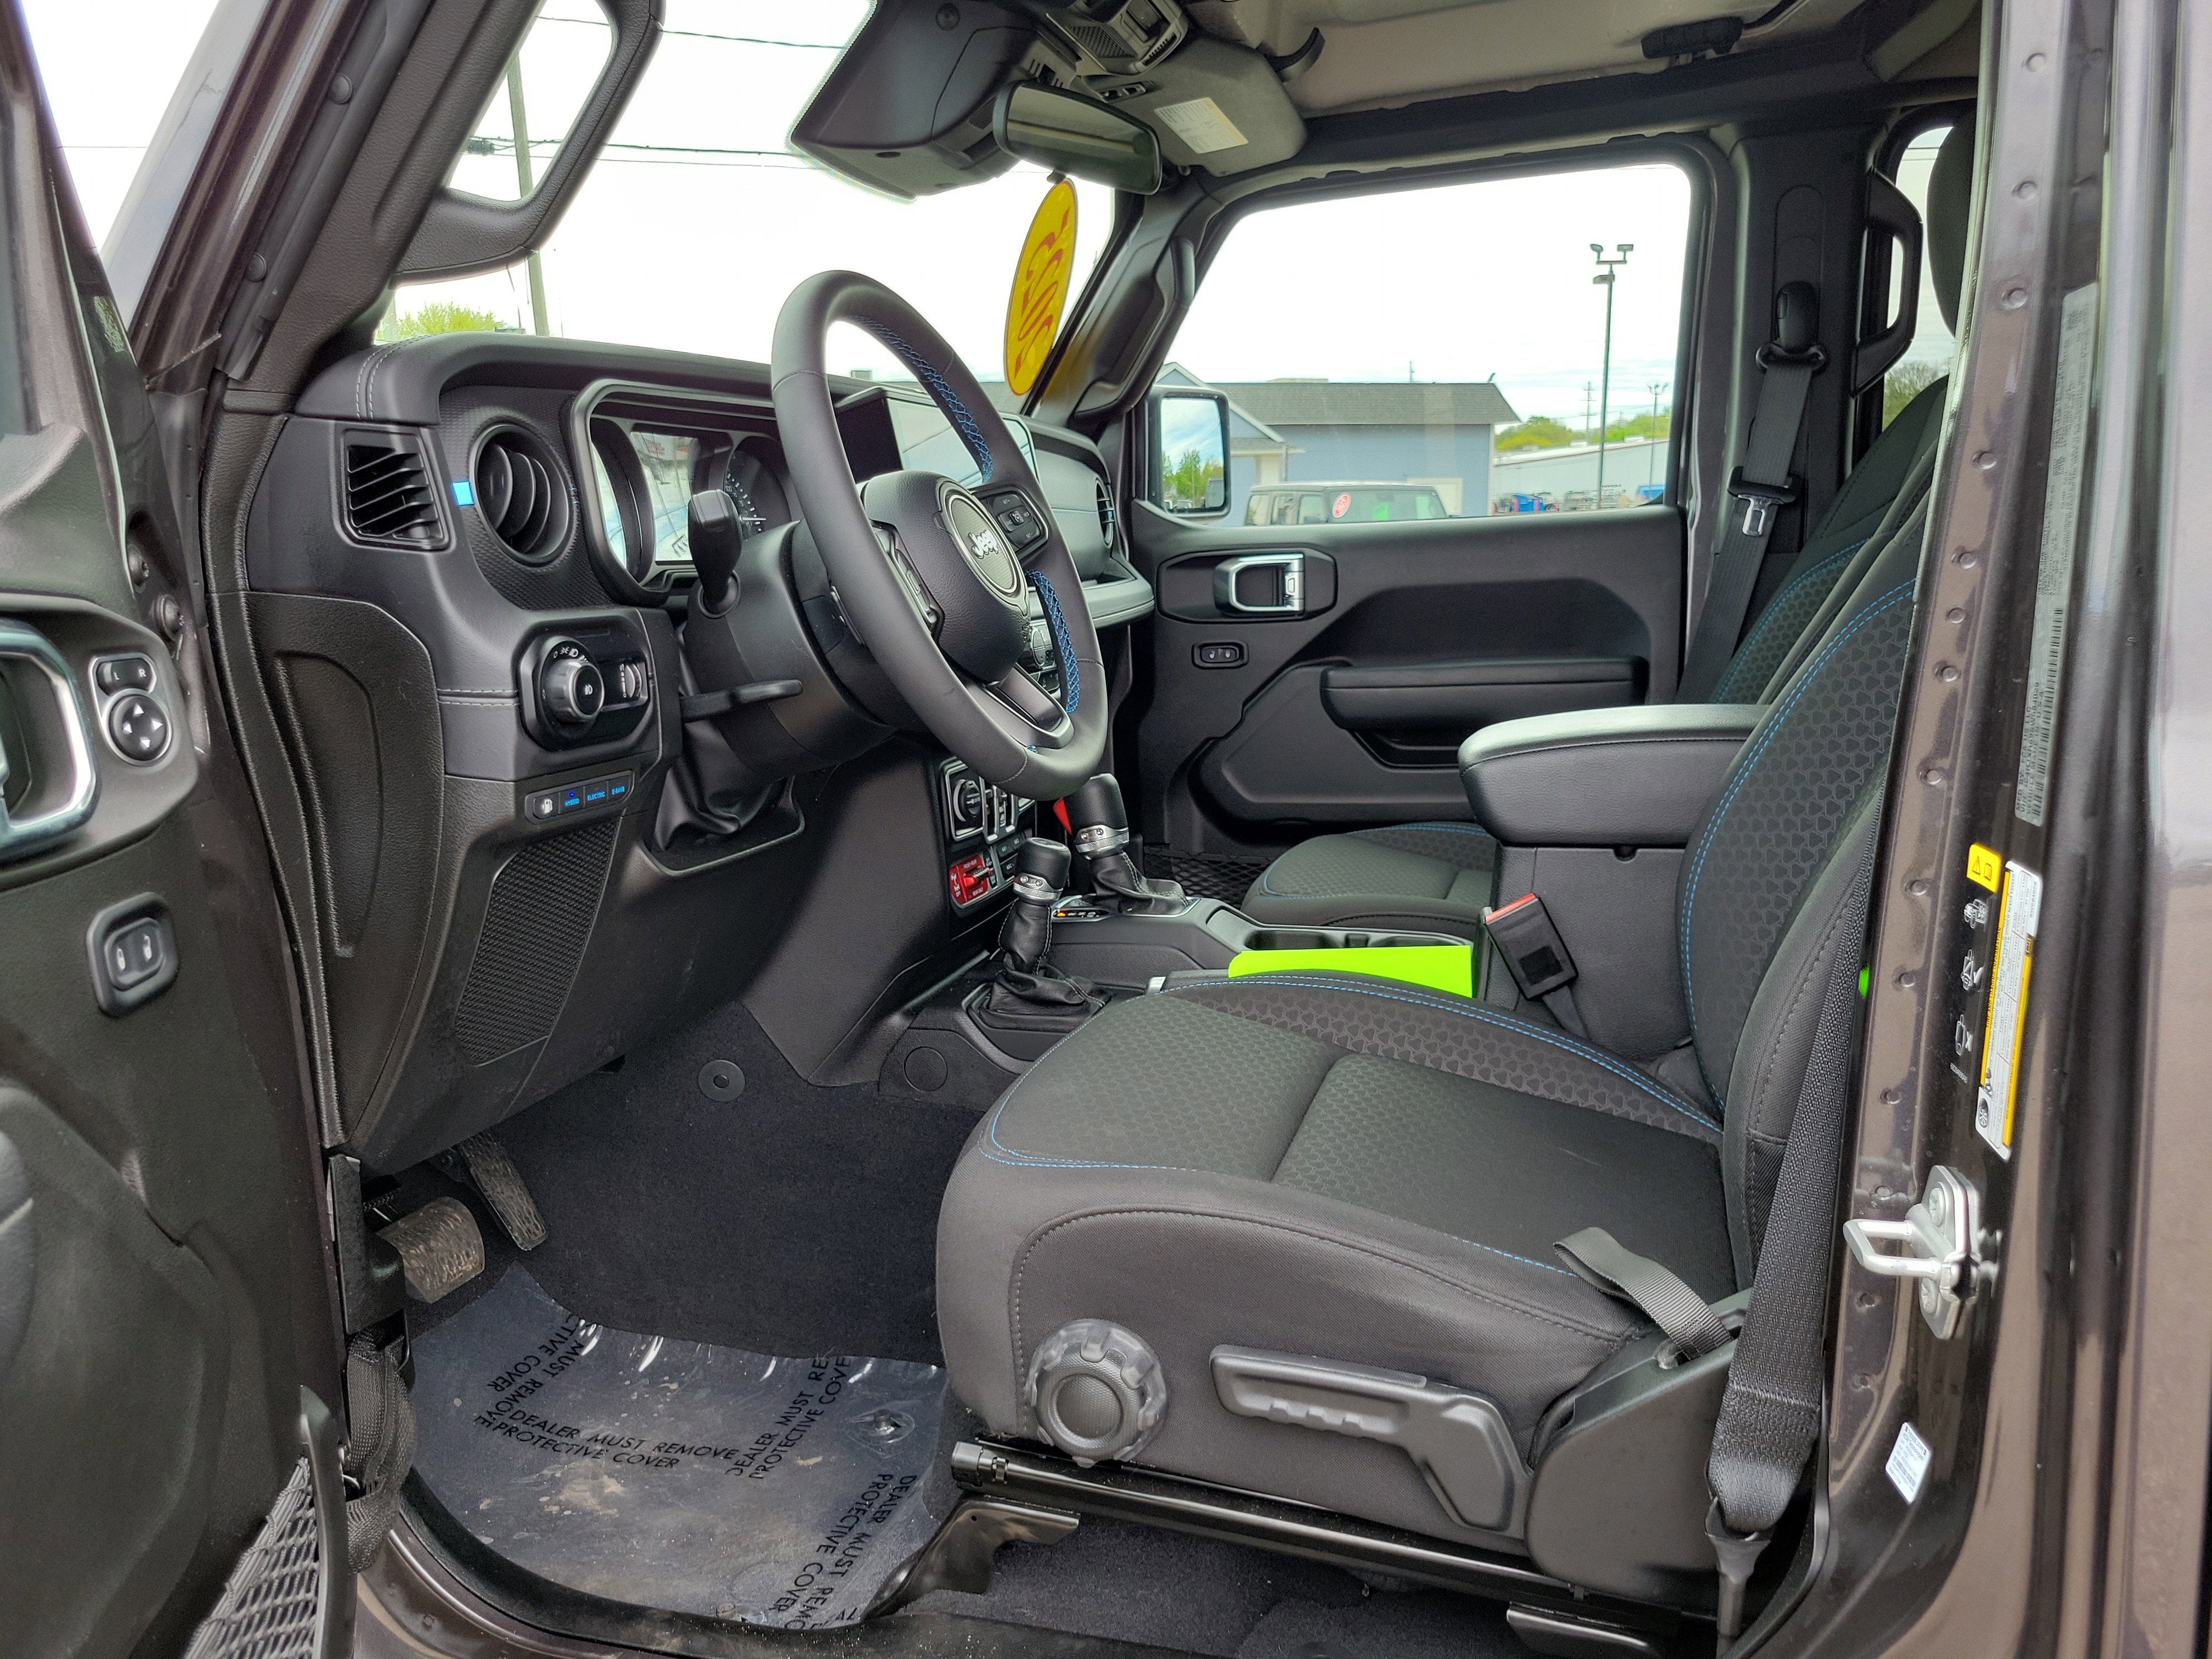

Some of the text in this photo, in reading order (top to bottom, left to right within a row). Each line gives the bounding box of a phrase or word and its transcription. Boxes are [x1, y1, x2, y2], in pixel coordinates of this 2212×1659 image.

[968, 528, 1000, 558] Jeep
[113, 668, 147, 681] L R
[586, 791, 606, 801] ELECTRIC
[475, 1340, 584, 1427] MUST REMOVE
[487, 1355, 540, 1392] COVER
[775, 1391, 814, 1425] MUST
[493, 1421, 680, 1468] PROTECTIVE COVER
[509, 1410, 739, 1459] DEALER MUST REMOVE
[749, 1409, 825, 1479] PROTECTIVE
[816, 1474, 893, 1554] PROTECTIVE
[867, 1475, 918, 1523] DEALER
[829, 1532, 872, 1577] MUST
[769, 1562, 823, 1612] COVER
